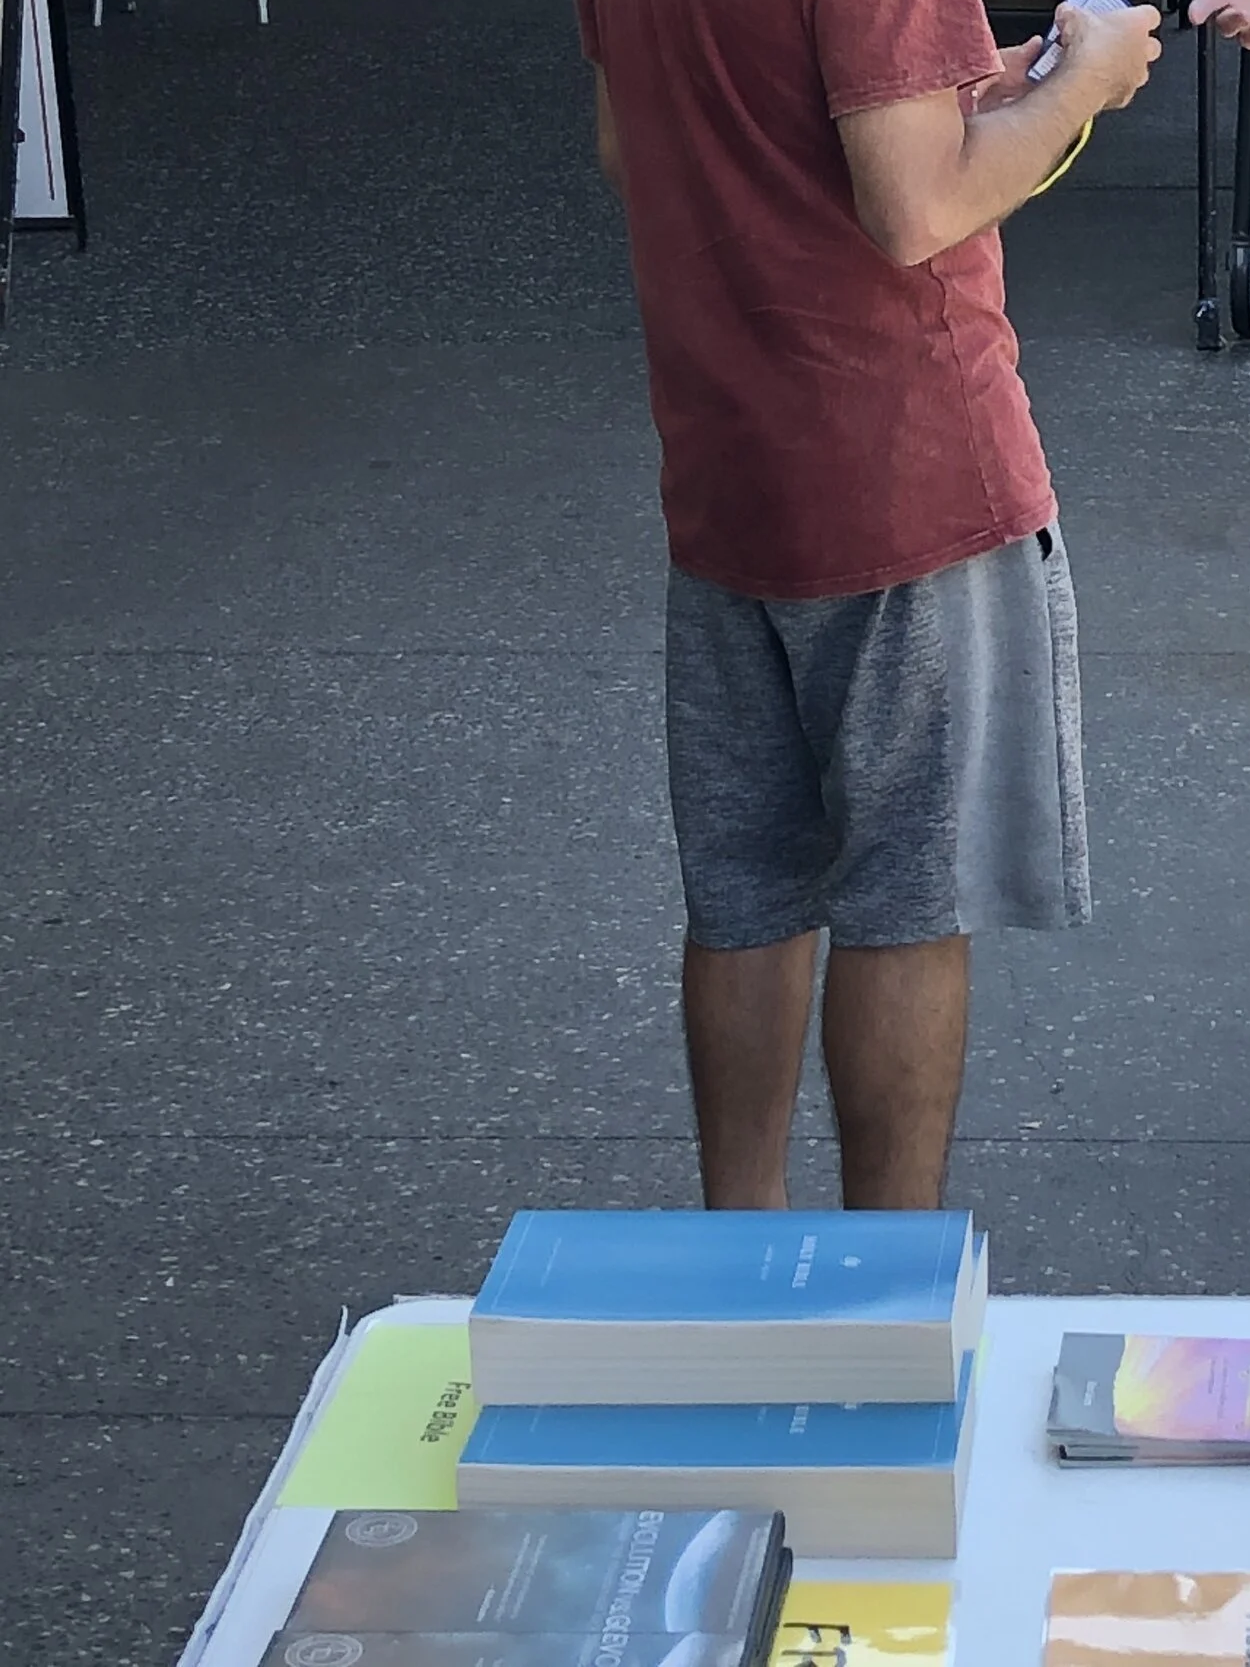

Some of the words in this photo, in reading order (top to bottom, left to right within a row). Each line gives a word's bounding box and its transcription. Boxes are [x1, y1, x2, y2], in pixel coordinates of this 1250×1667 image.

[437, 1381, 472, 1408] Free
[420, 1411, 458, 1443] Bible
[616, 1510, 665, 1595] EVOLUTION
